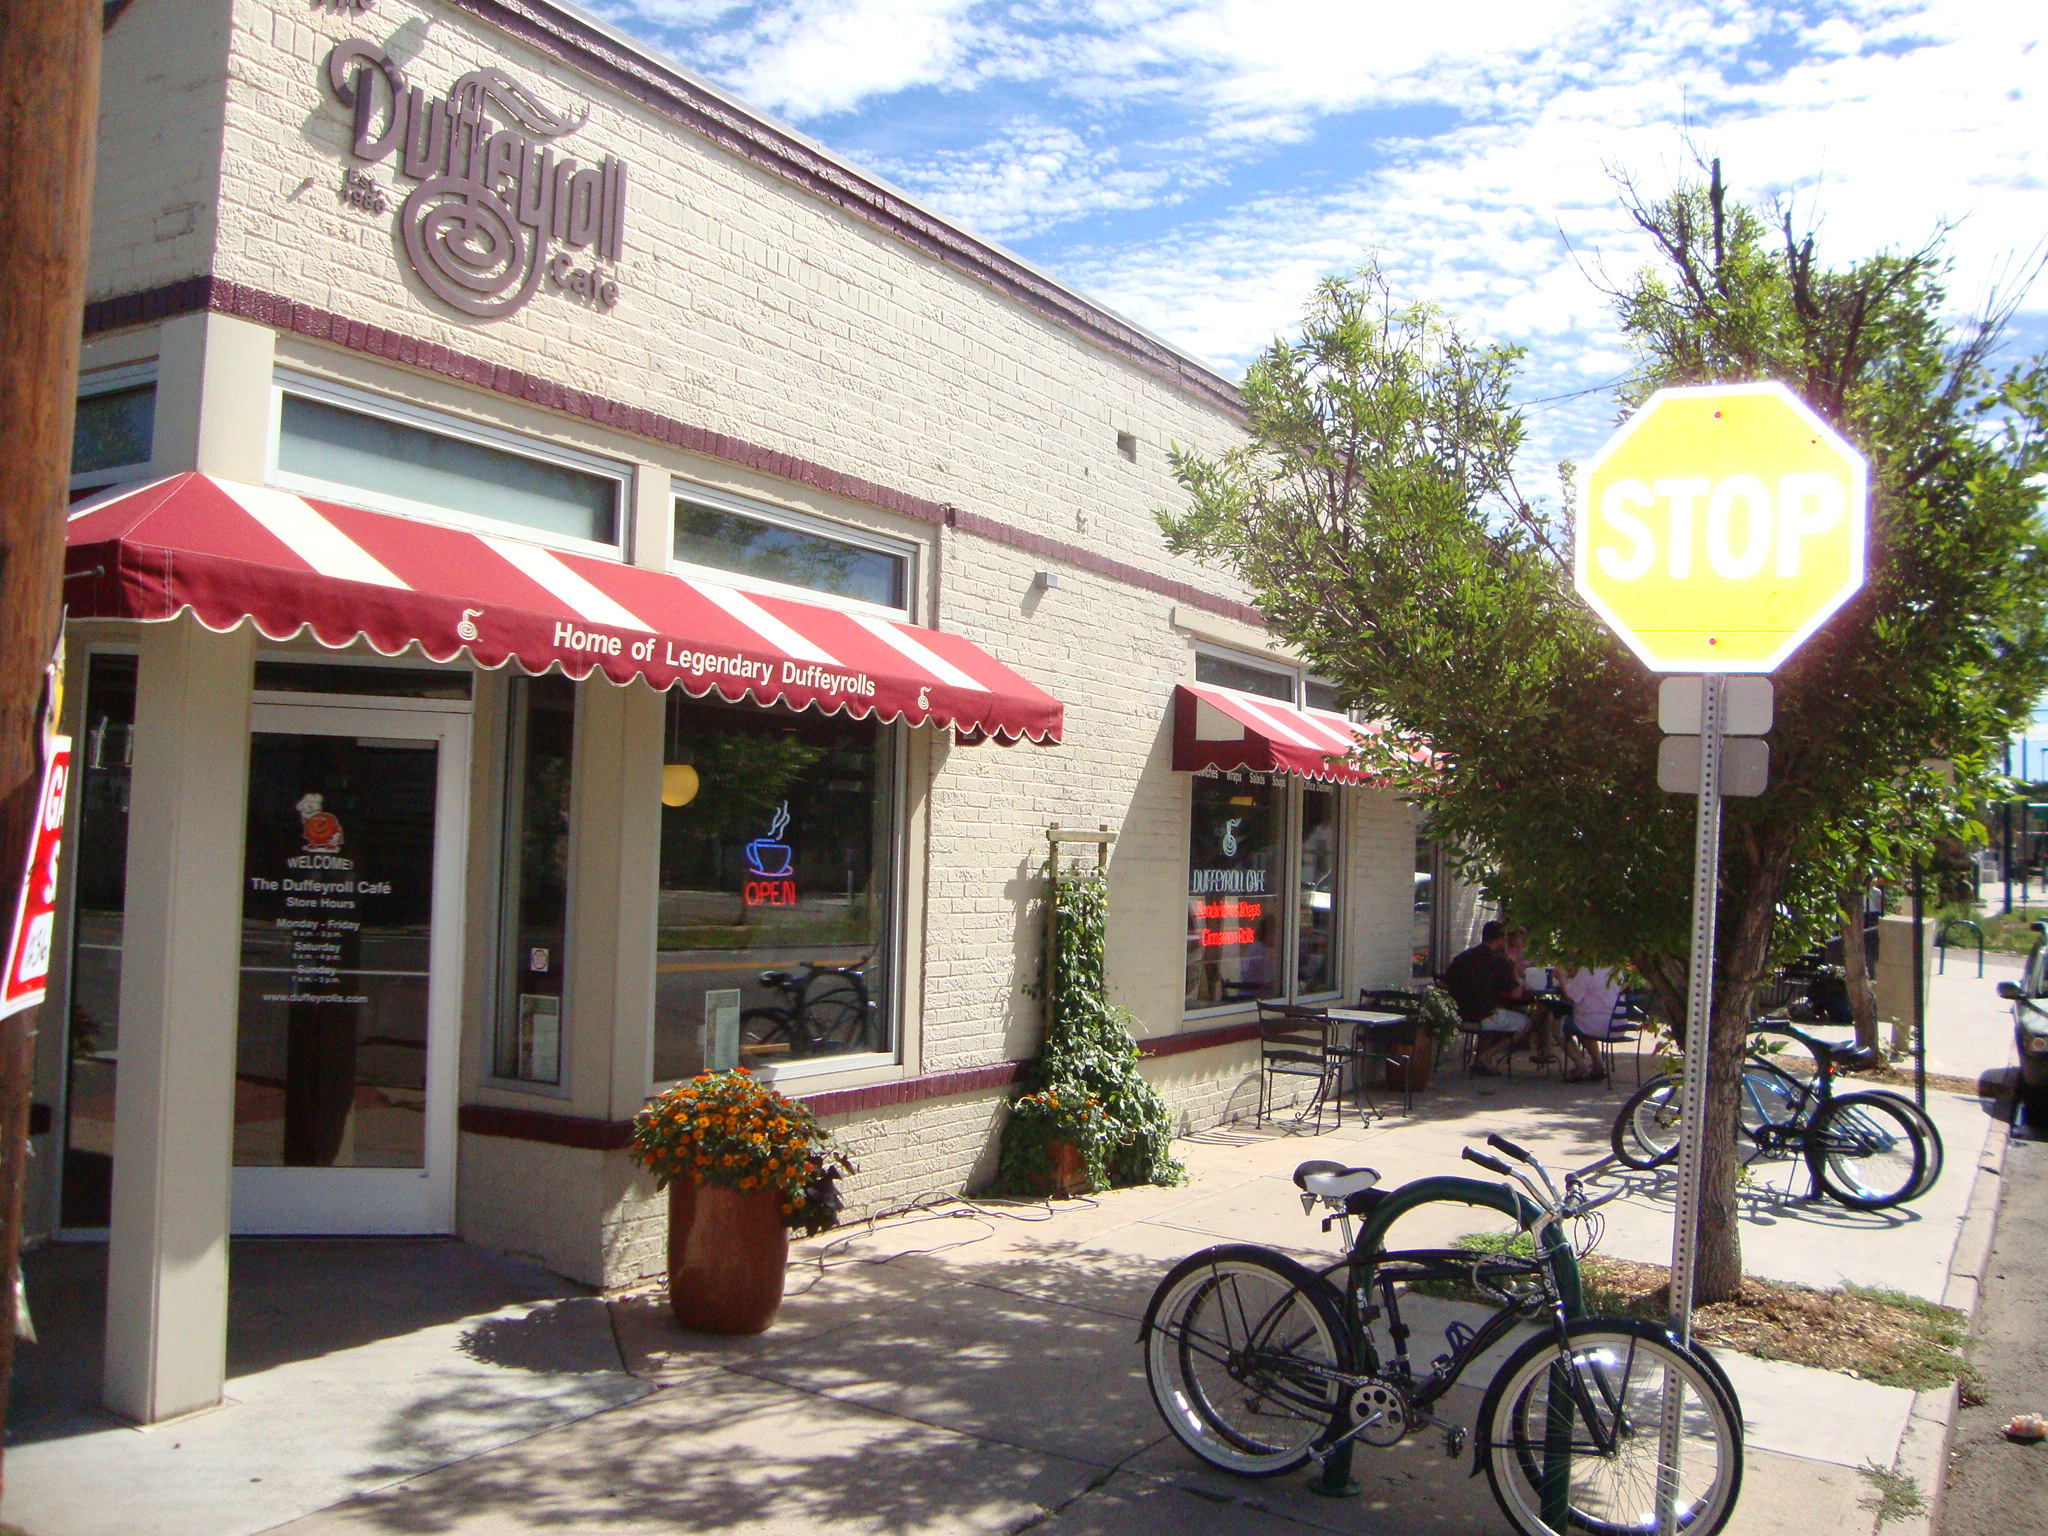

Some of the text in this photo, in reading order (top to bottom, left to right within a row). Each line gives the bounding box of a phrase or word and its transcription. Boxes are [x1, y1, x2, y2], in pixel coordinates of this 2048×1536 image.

[329, 38, 627, 317] Duffeyroll
[552, 252, 620, 308] Cafe
[1597, 474, 1844, 580] STOP
[554, 621, 876, 698] Home of Legendary Duffeyrolls
[1249, 771, 1266, 785] Salads
[251, 877, 279, 891] The
[282, 879, 354, 895] Duffeyroll
[745, 880, 796, 906] OPEN
[286, 896, 355, 909] Store Hours
[276, 918, 318, 930] Monday
[327, 919, 360, 932] Friday
[294, 941, 341, 953] Saturday
[297, 964, 337, 976] Sunday
